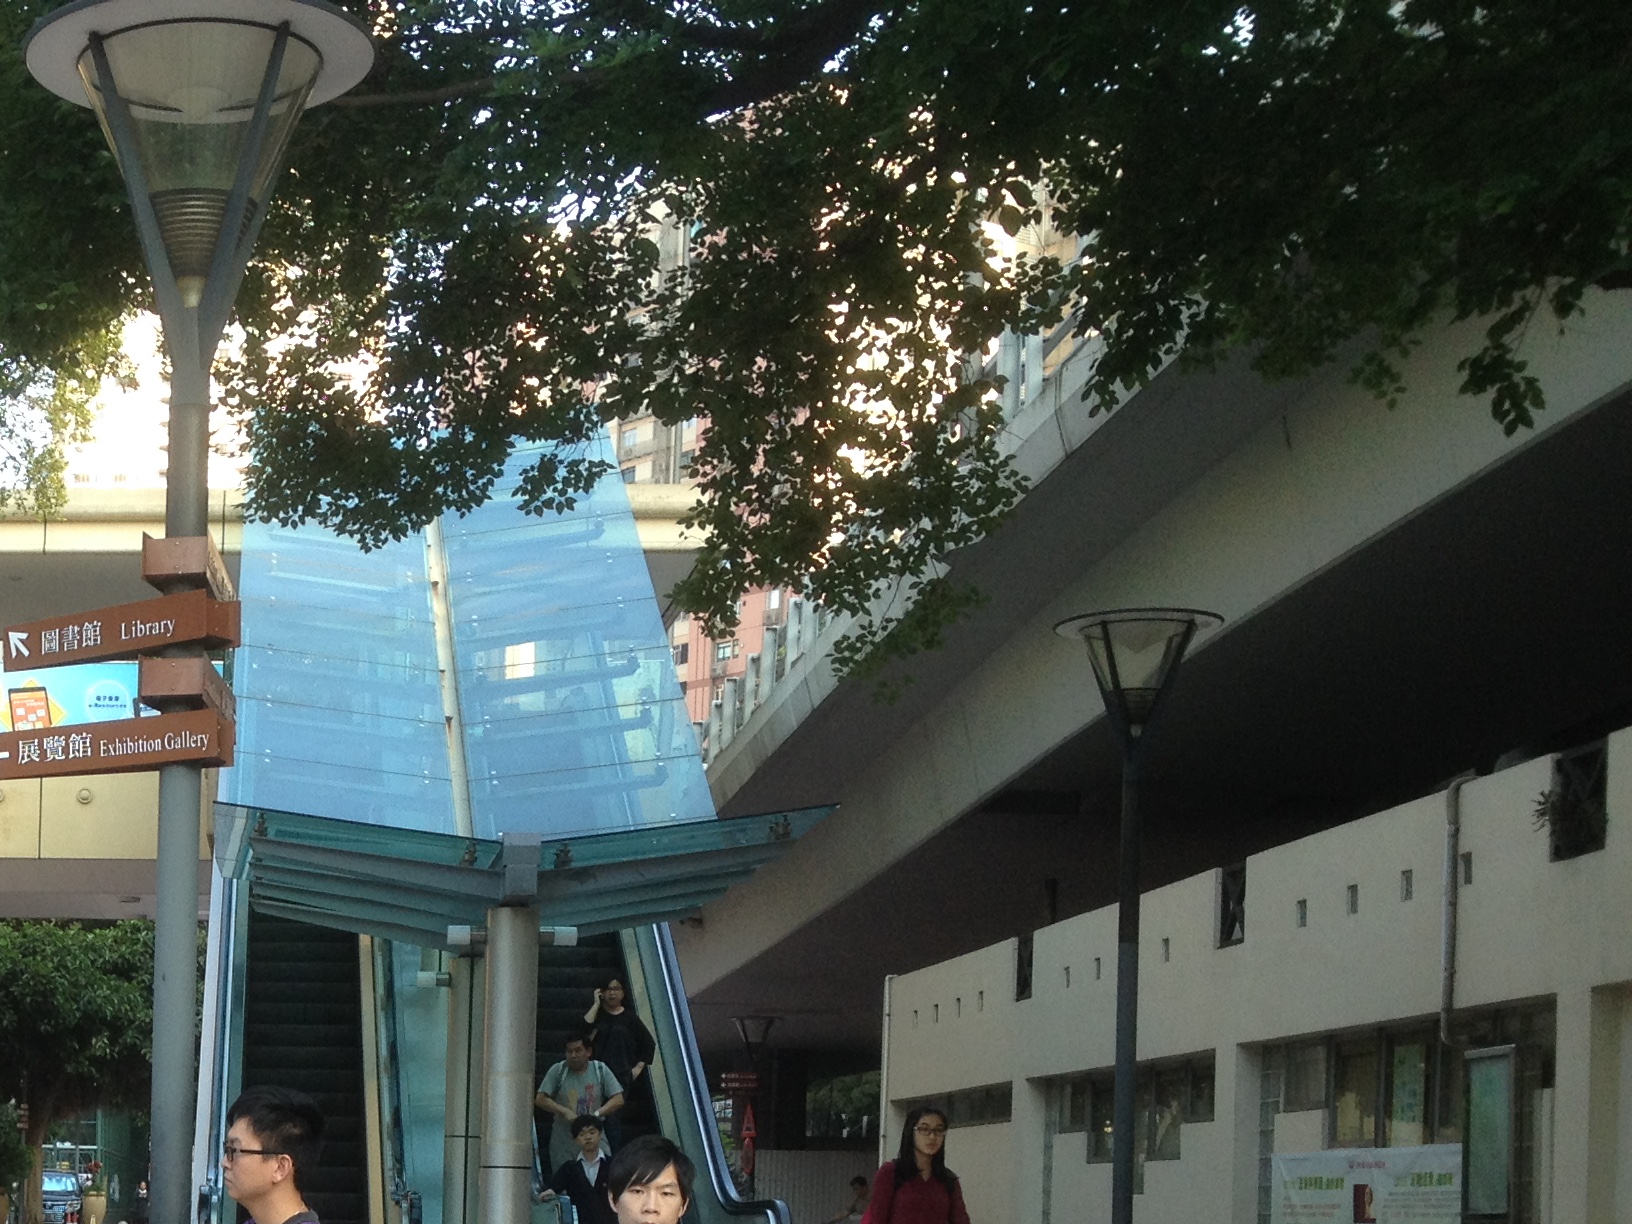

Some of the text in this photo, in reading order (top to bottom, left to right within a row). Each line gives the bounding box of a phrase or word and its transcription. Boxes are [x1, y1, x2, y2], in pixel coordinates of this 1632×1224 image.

[41, 619, 176, 655] 圖書館 Library
[18, 730, 210, 764] 展覽館 Exhibition Gallery
